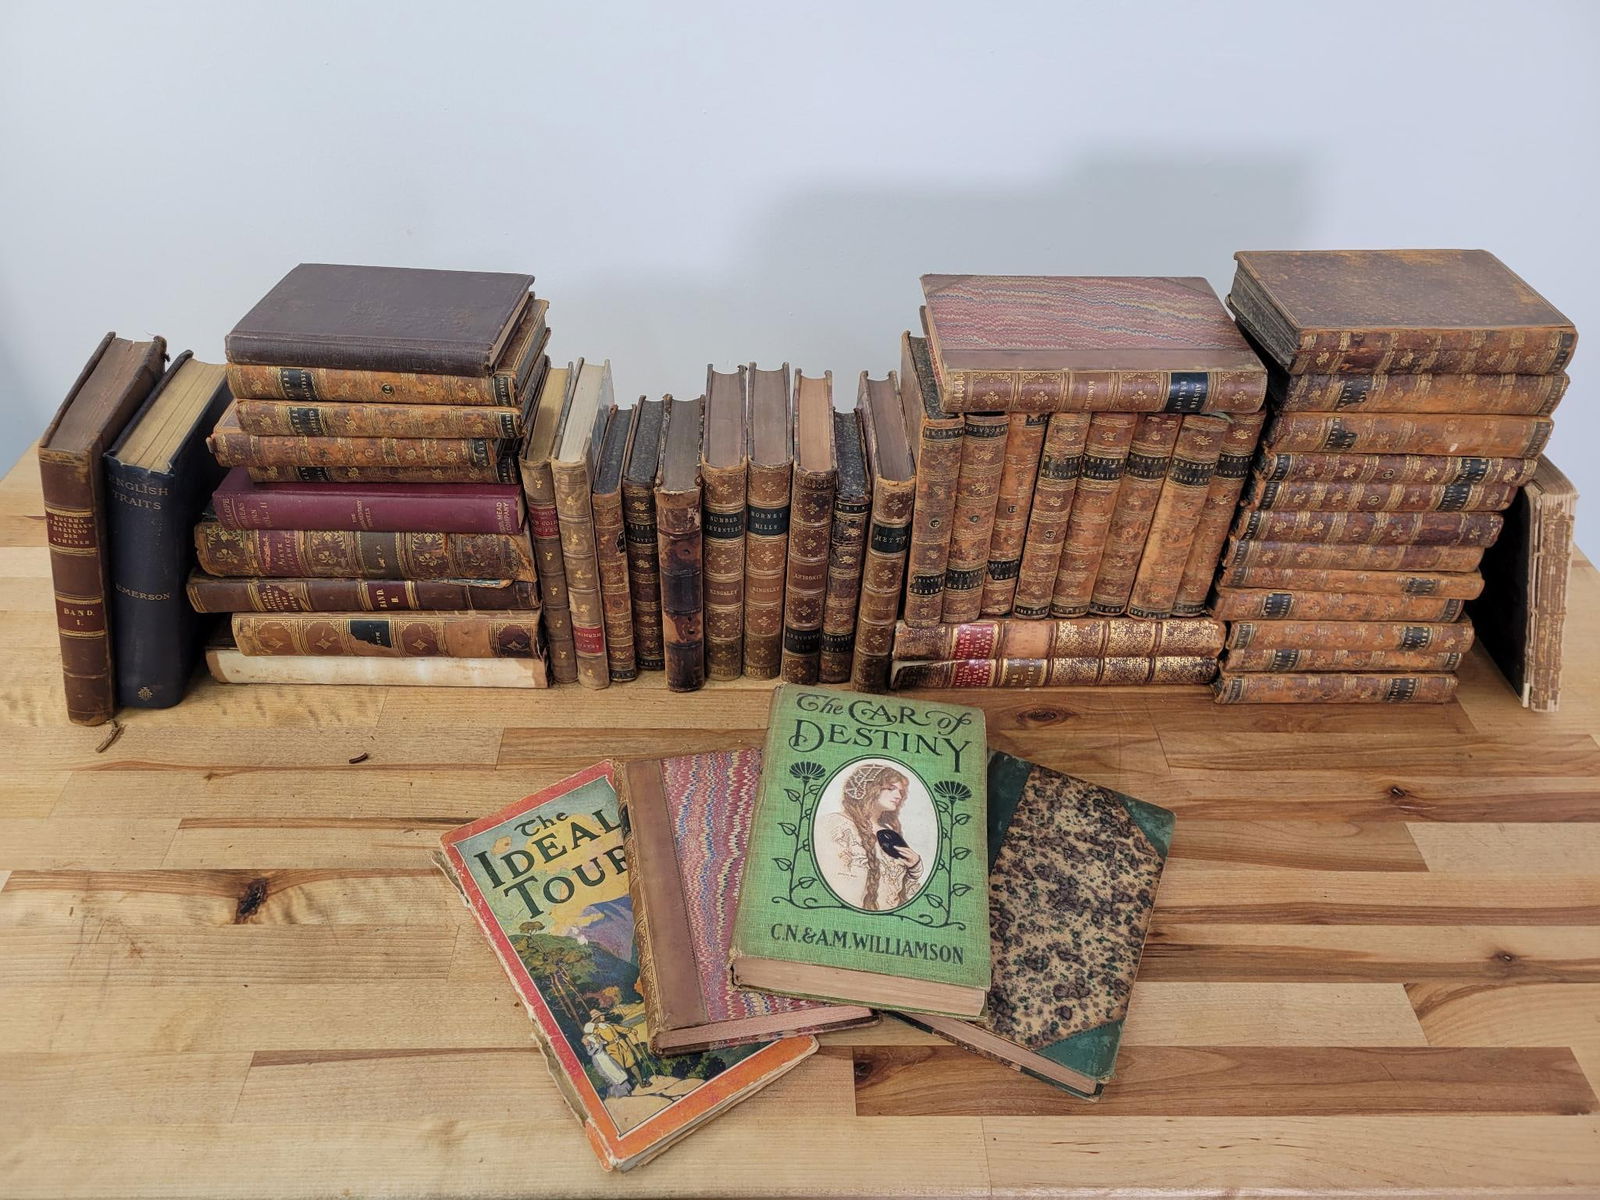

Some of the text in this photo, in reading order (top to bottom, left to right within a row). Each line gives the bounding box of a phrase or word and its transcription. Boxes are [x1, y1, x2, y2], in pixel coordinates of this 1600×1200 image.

[1189, 383, 1202, 409] AUSTIN
[112, 489, 162, 511] TRAITS
[708, 515, 738, 523] NUMBER
[874, 534, 907, 545] HETTY
[114, 582, 171, 602] EMERSON
[795, 692, 973, 736] The CAR of
[788, 718, 973, 774] DESTINY
[513, 811, 569, 837] The
[473, 808, 622, 889] IDEAL
